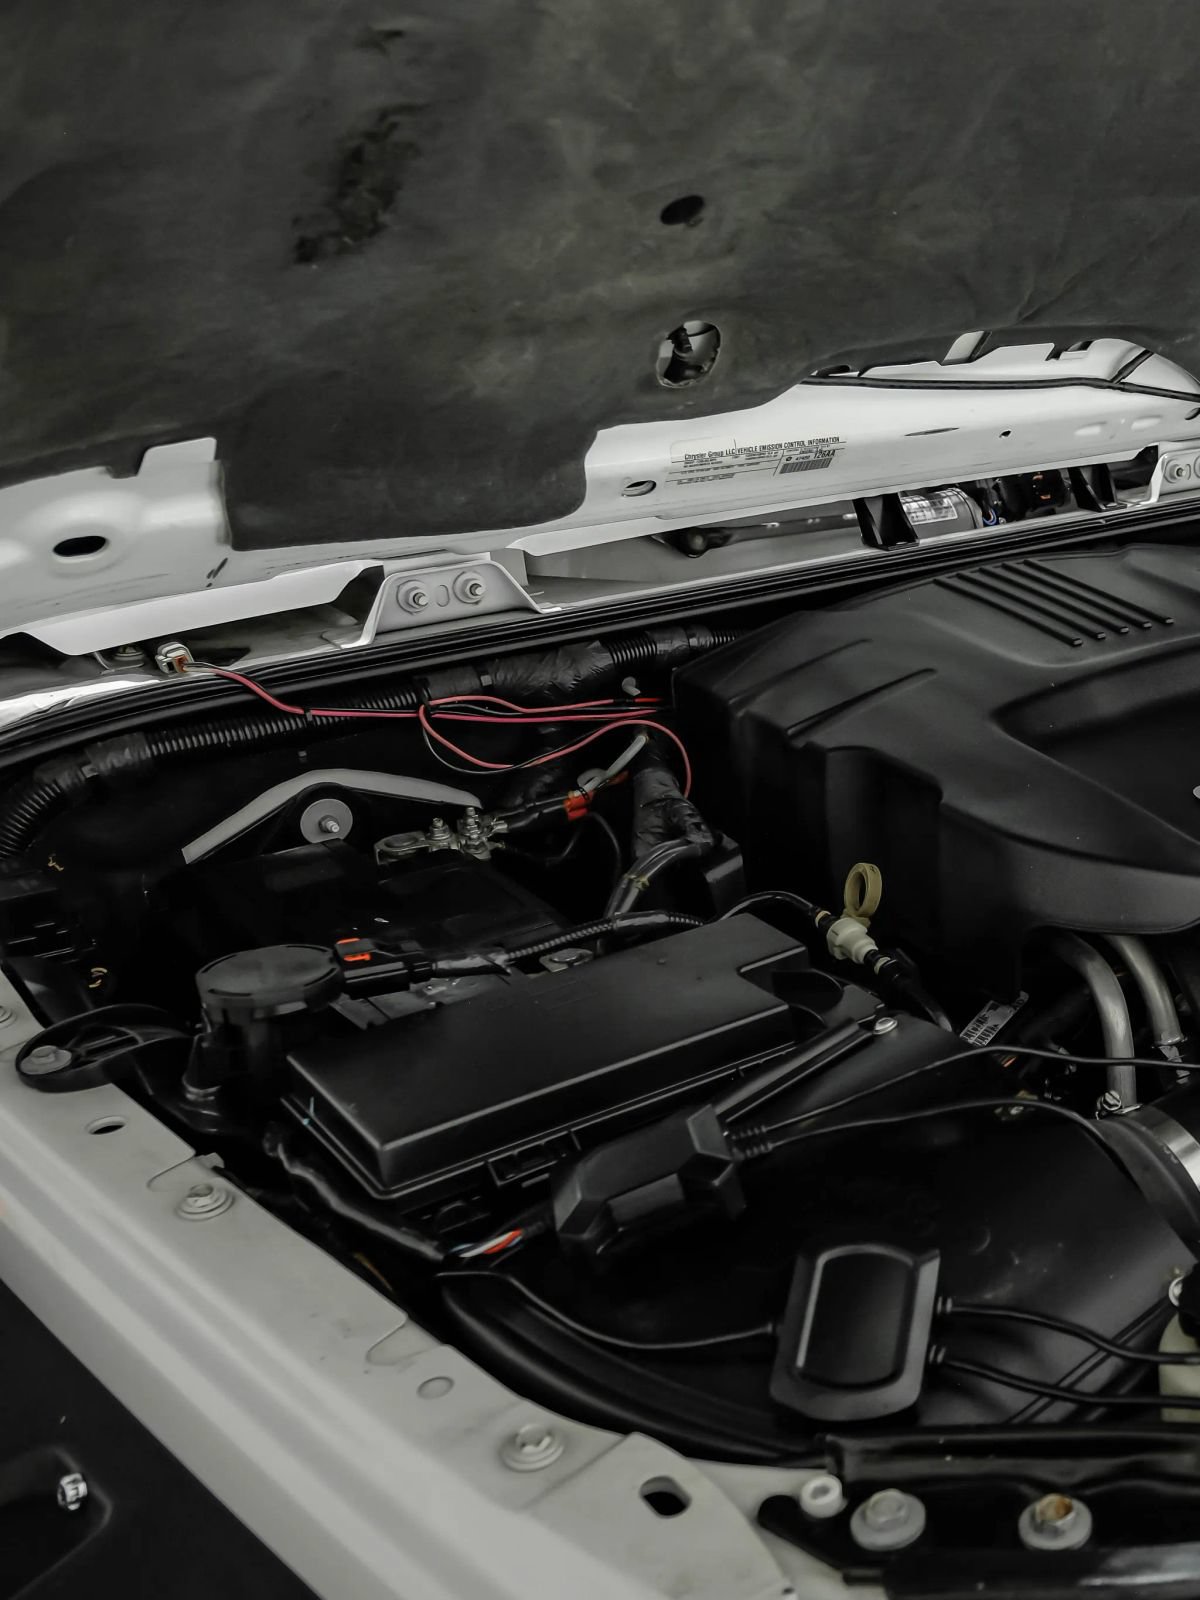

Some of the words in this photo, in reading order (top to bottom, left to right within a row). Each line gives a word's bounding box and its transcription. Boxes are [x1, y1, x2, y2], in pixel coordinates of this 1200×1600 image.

[725, 448, 736, 456] LLC
[737, 446, 758, 454] VEHICLE
[759, 443, 782, 451] EMISSION
[784, 440, 806, 448] CONTROL
[807, 437, 840, 445] INFORMATION
